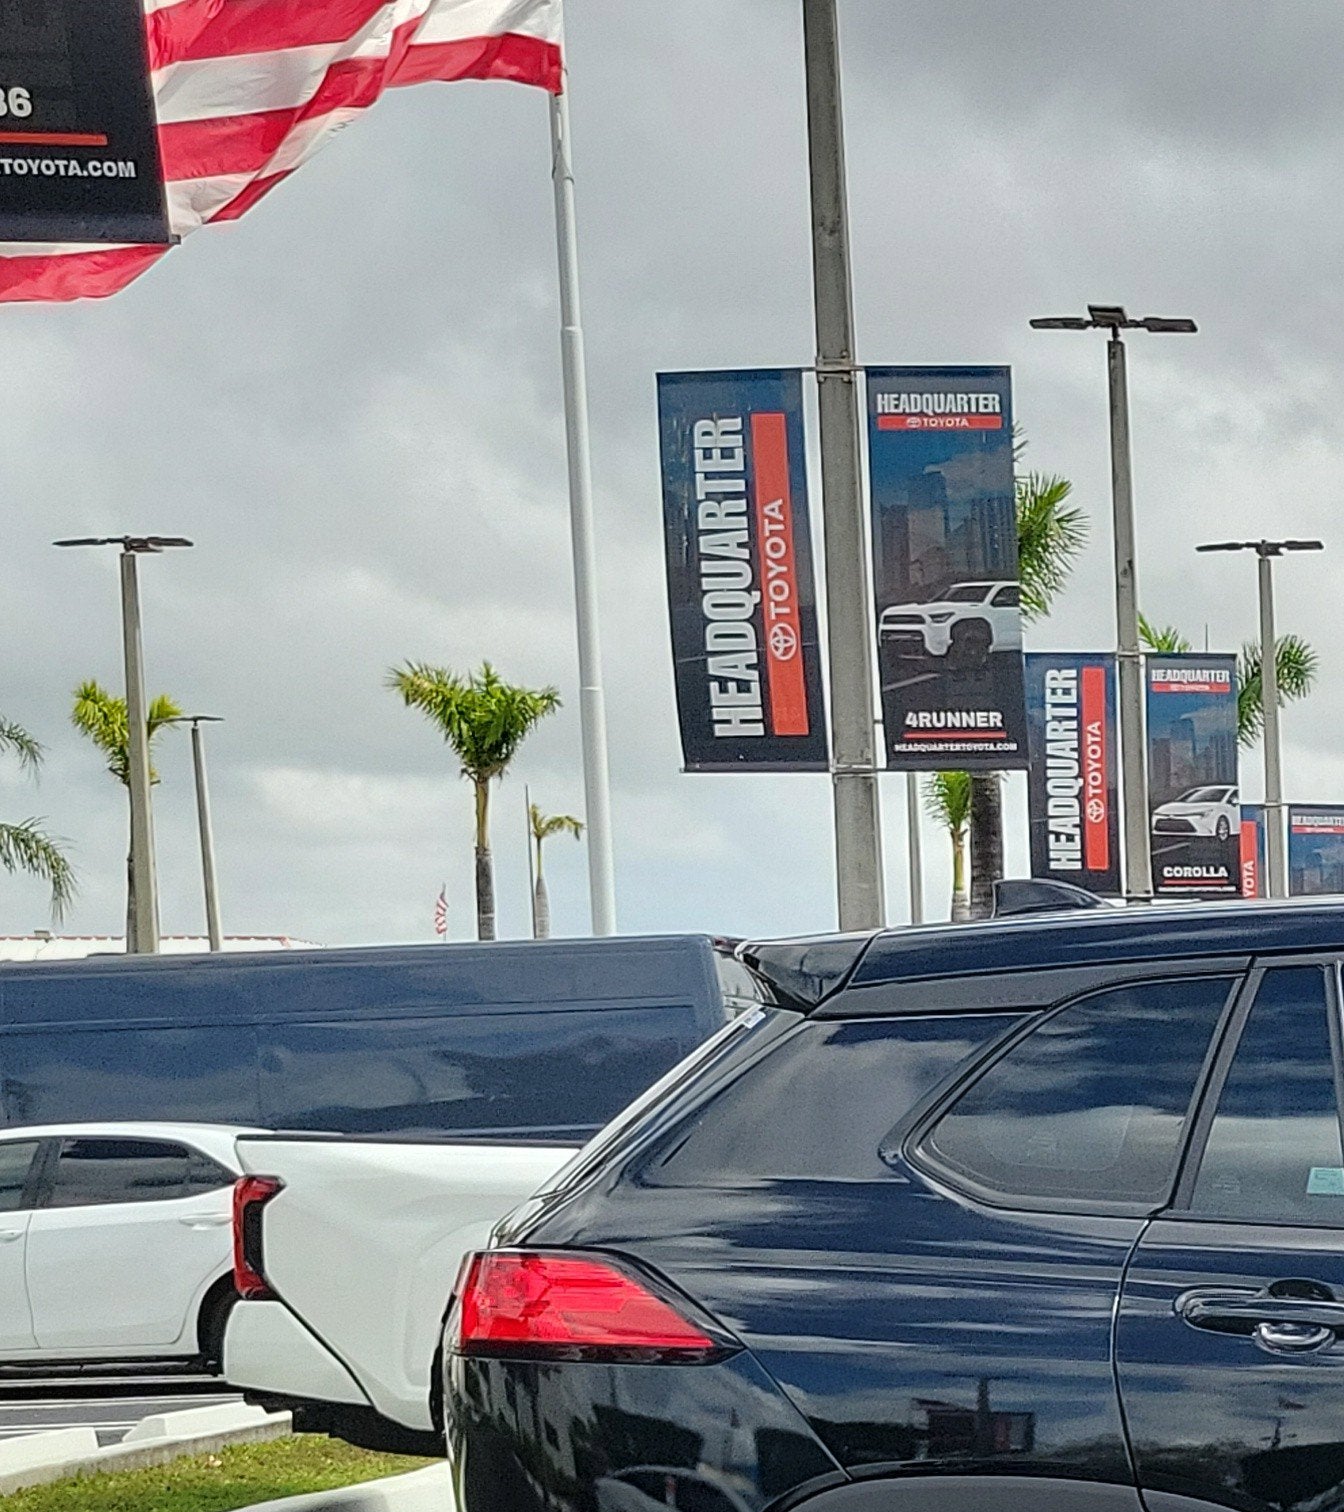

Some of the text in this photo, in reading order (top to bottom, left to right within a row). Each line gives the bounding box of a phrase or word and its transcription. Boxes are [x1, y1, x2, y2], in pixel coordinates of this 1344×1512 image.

[0, 159, 136, 177] TOYOTA.COM
[877, 394, 1001, 414] HEADQUARTER
[922, 418, 969, 428] TOYOTA
[763, 499, 788, 619] TOYOTA
[694, 415, 764, 737] HEADQUARTER
[1152, 669, 1230, 683] HEADQUARTER
[905, 711, 1003, 728] 4RUNNER
[1088, 721, 1104, 796] TOYOTA
[1045, 669, 1083, 870] HEADQUARTER
[1163, 866, 1228, 877] COROLLA
[1243, 860, 1255, 898] YOTA
